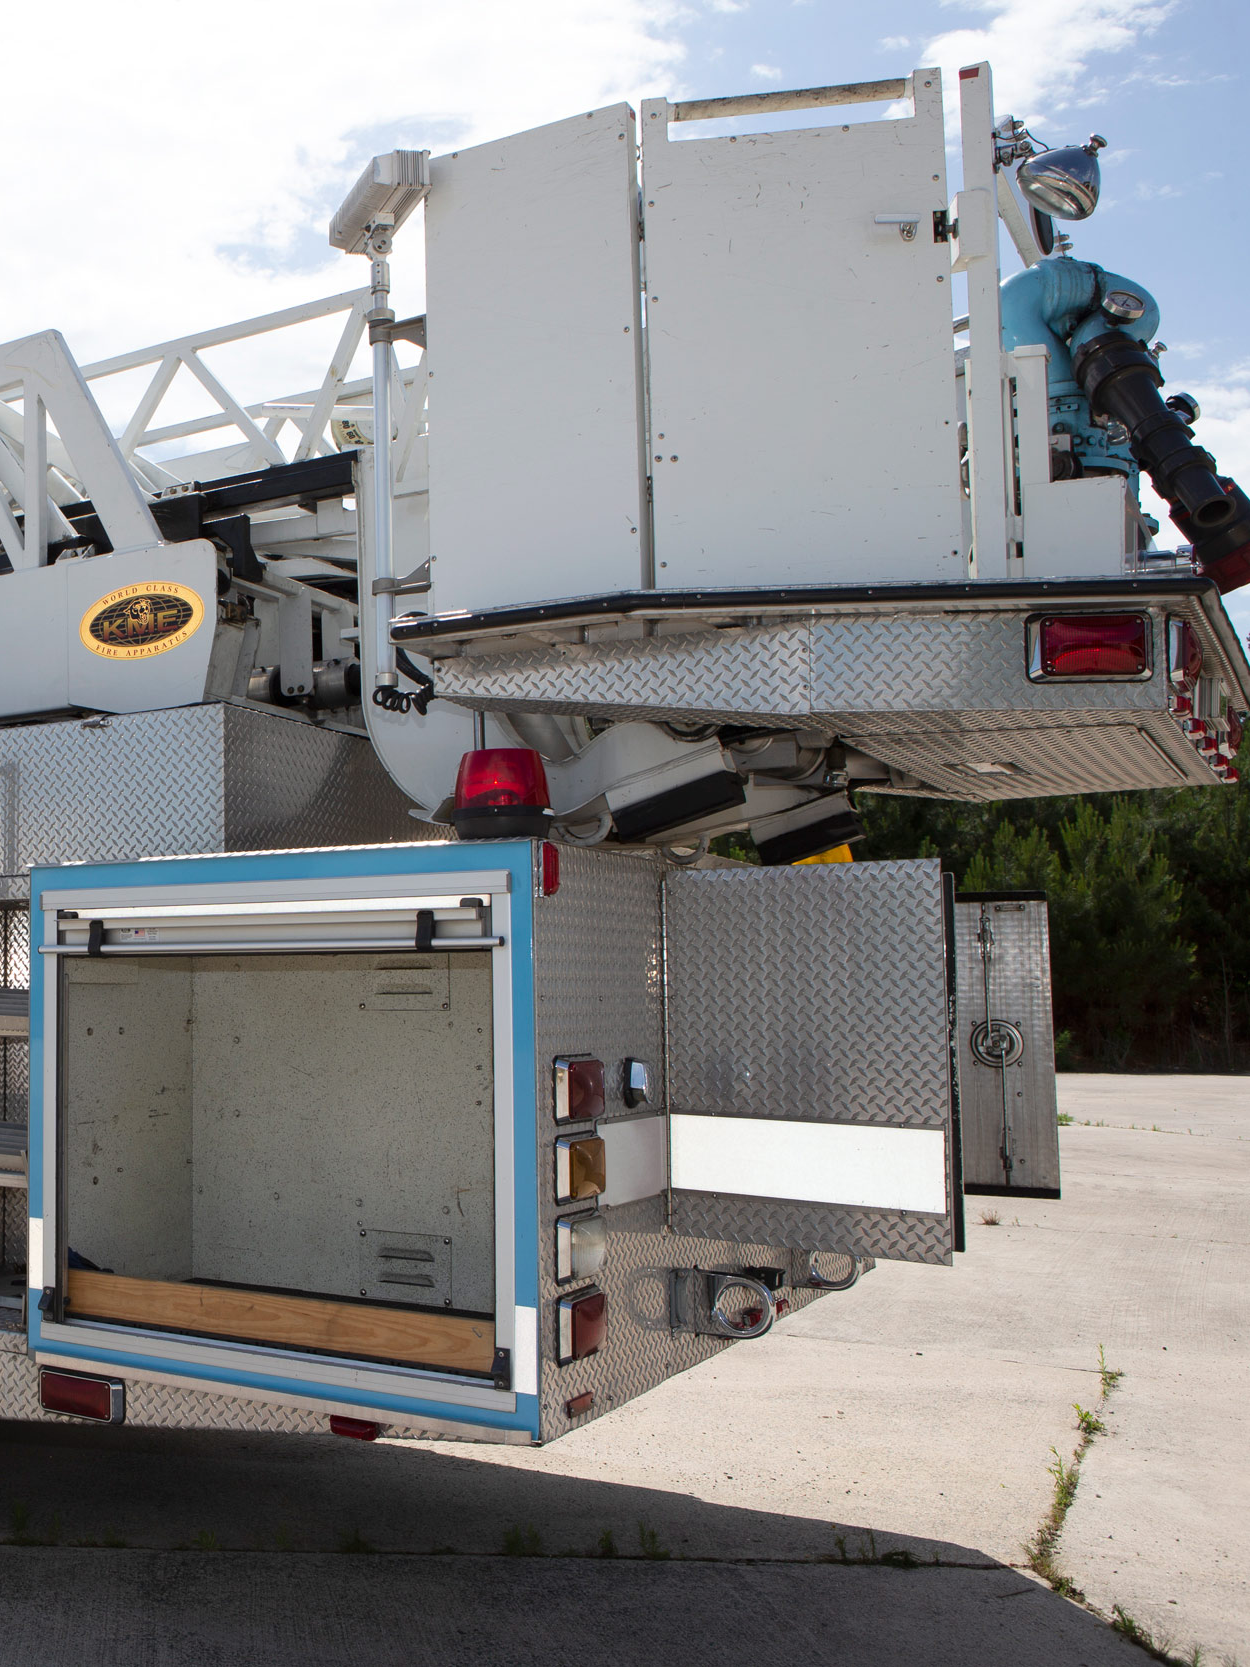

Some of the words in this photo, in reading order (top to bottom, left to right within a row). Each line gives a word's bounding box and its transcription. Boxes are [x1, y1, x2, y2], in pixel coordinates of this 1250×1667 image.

[102, 587, 138, 606] WORLD
[146, 584, 179, 594] CLASS
[102, 609, 178, 641] KME
[95, 644, 118, 656] FIRE
[125, 630, 188, 657] APPARATUS
